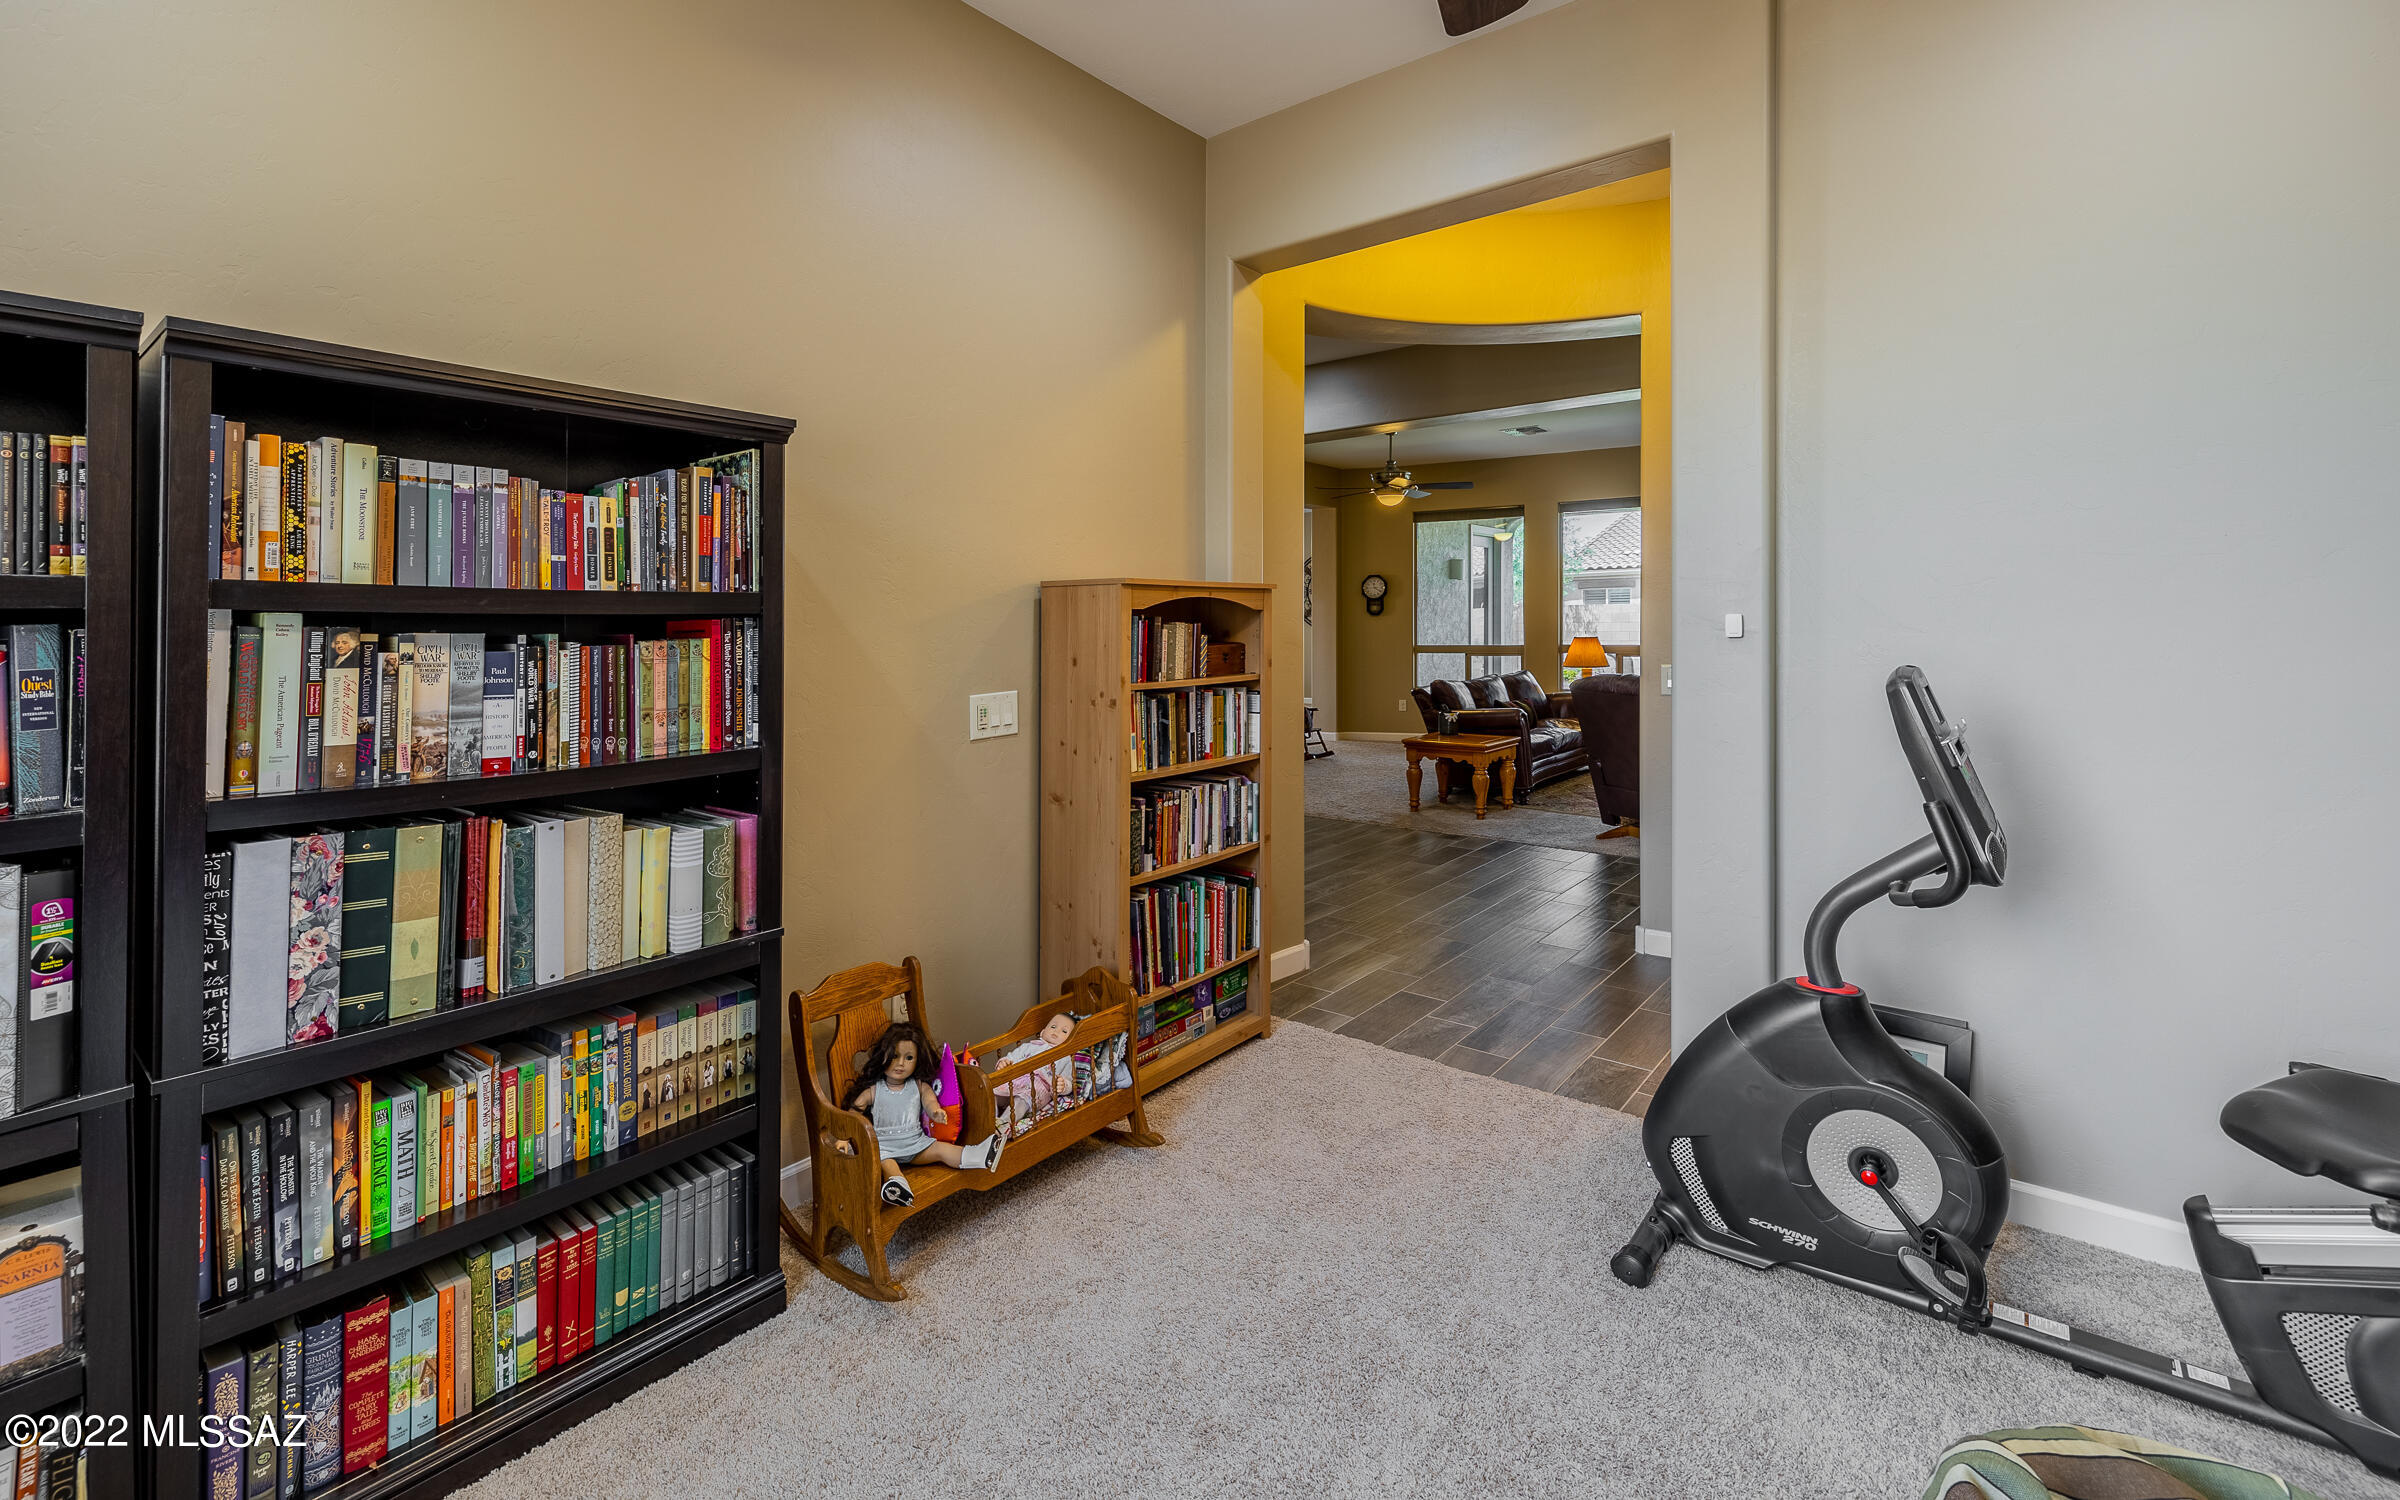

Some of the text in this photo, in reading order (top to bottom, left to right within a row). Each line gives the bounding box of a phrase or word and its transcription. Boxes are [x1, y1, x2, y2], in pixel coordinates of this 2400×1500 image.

[308, 631, 323, 652] Killing
[363, 644, 373, 666] DAVID
[308, 654, 323, 680] England
[491, 667, 507, 675] Paul
[21, 677, 52, 693] Quest
[332, 677, 341, 694] DAVID
[343, 675, 357, 698] John
[484, 676, 513, 684] Johnson
[21, 690, 54, 701] Study Bible
[236, 686, 249, 731] HISTORY
[276, 676, 286, 748] The American Pageant
[623, 1032, 632, 1098] THE OFFICIAL GUIDE
[482, 1074, 491, 1110] Charlotte's
[397, 1128, 414, 1180] MATH
[372, 1139, 388, 1192] SCIENCE
[220, 1159, 229, 1230] DARK SEA OF DARKNESS
[252, 1199, 261, 1219] EATEN
[284, 1216, 292, 1250] PETERSON
[313, 1206, 322, 1240] PETERSON
[1749, 1218, 1818, 1244] SCHWINN
[227, 1234, 235, 1270] PETERSON
[254, 1226, 263, 1260] PETERSON
[1782, 1235, 1816, 1251] 270
[0, 1261, 60, 1286] NARNIA
[349, 1335, 386, 1354] CHRISTIAN
[357, 1333, 378, 1344] HANS
[350, 1342, 386, 1360] ANDERSEN
[286, 1340, 297, 1400] HARPER LEE
[348, 1390, 385, 1410] COMPLETE
[357, 1402, 377, 1415] FAIRY
[352, 1417, 381, 1435] STORIES
[355, 1409, 378, 1422] TALES
